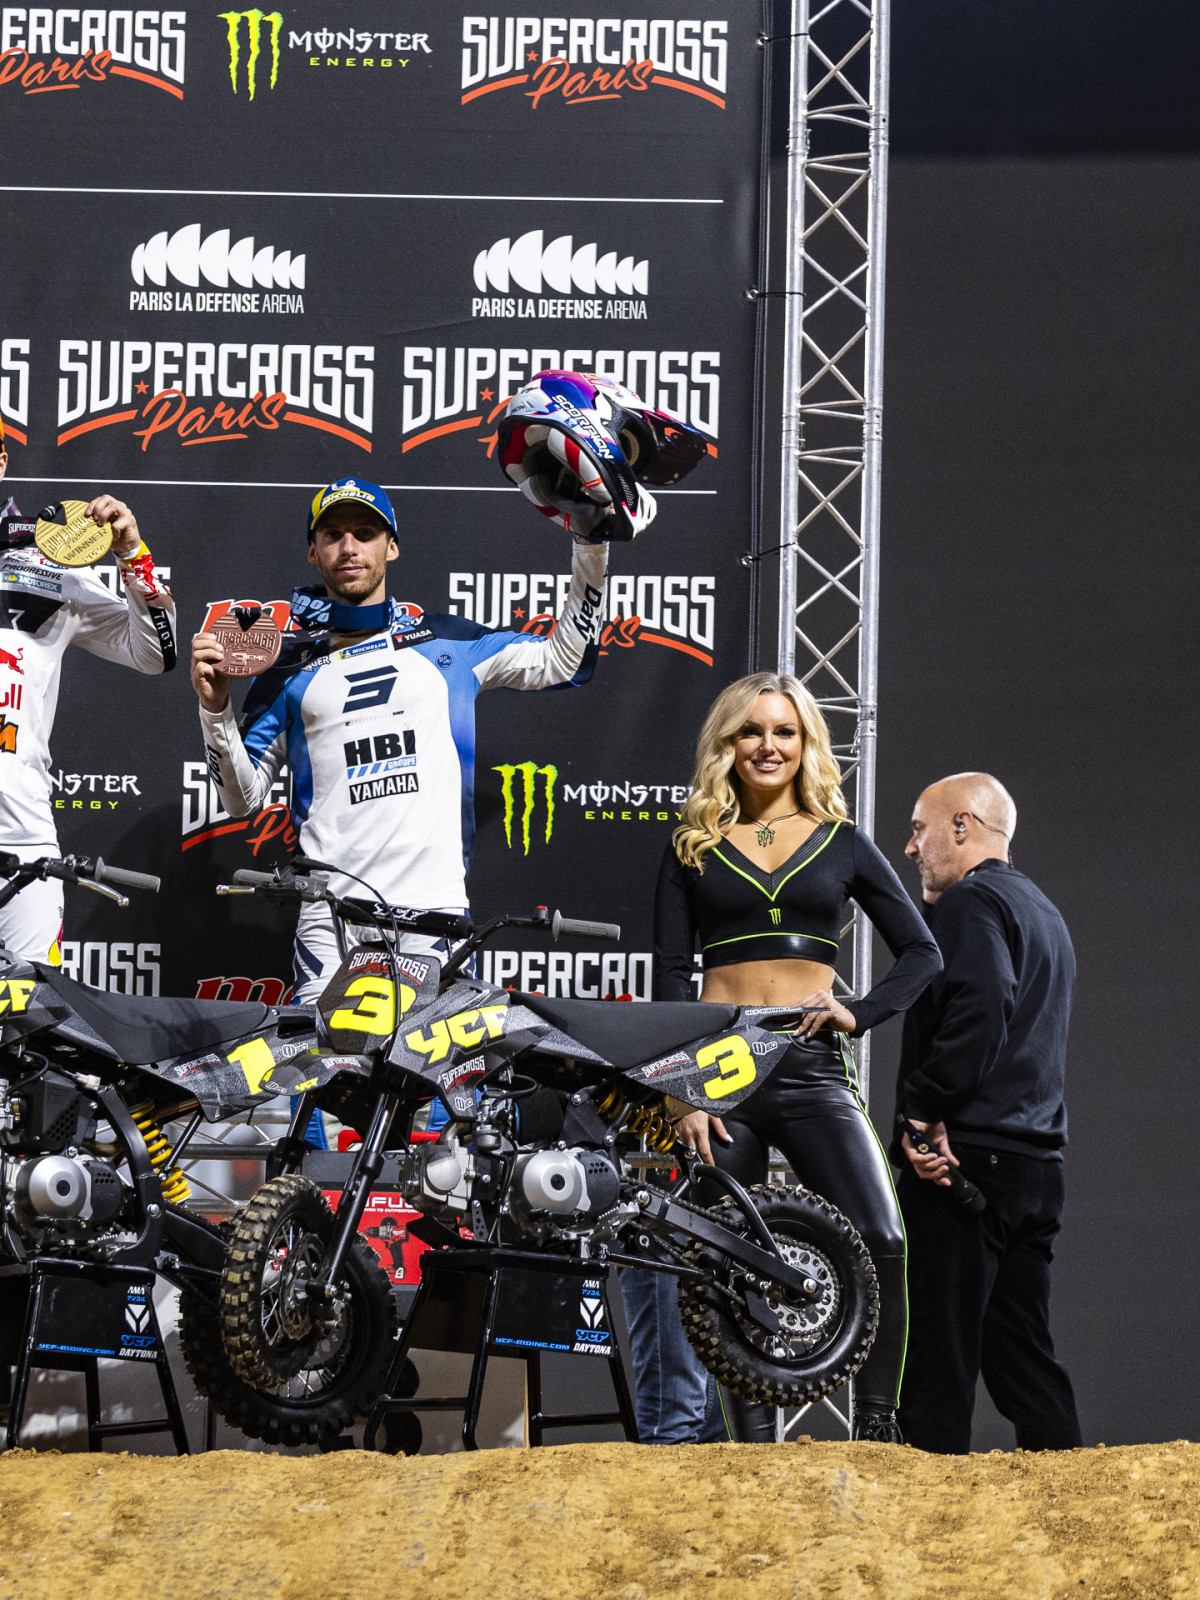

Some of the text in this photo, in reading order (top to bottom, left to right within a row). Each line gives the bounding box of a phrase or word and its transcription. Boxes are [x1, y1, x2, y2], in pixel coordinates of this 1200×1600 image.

[288, 26, 433, 56] MONSTER
[461, 16, 729, 94] SUPERCROSS
[309, 57, 410, 69] ENERGY
[525, 57, 654, 110] Paris
[129, 290, 305, 314] PARIS LA DEFENSE ARENA
[471, 297, 648, 320] PARIS LA DEFENSE ARENA
[58, 338, 375, 434] SUPERCROSS
[133, 388, 287, 452] Paris
[551, 394, 615, 460] SCORPION
[322, 489, 375, 506] MICHELIN
[63, 528, 108, 562] WINNER
[2, 564, 64, 581] PROGRESSIVE
[18, 575, 58, 591] MOTOREX
[573, 582, 603, 643] Dafy
[351, 641, 387, 654] MICHELIN
[404, 629, 433, 641] YUASA
[344, 729, 417, 769] HBI
[387, 757, 417, 771] GROUPE
[351, 773, 418, 802] YAMAHA
[55, 799, 119, 811] ERGY
[585, 810, 683, 821] ENERGY
[351, 952, 430, 984] SUPERCROSS
[329, 976, 416, 1036] 3
[404, 1004, 509, 1065] YCF
[226, 1037, 276, 1096] 1
[442, 1055, 486, 1090] SUPERCROSS
[641, 1051, 690, 1078] SUPERCROSS
[696, 1034, 757, 1100] 3
[121, 1334, 156, 1348] YCF
[495, 1337, 612, 1355] YCF-RIDING.COM DAYTONA
[576, 1328, 610, 1343] YCF
[38, 1343, 158, 1359] YCF-RIDING.COM DAYTONA
